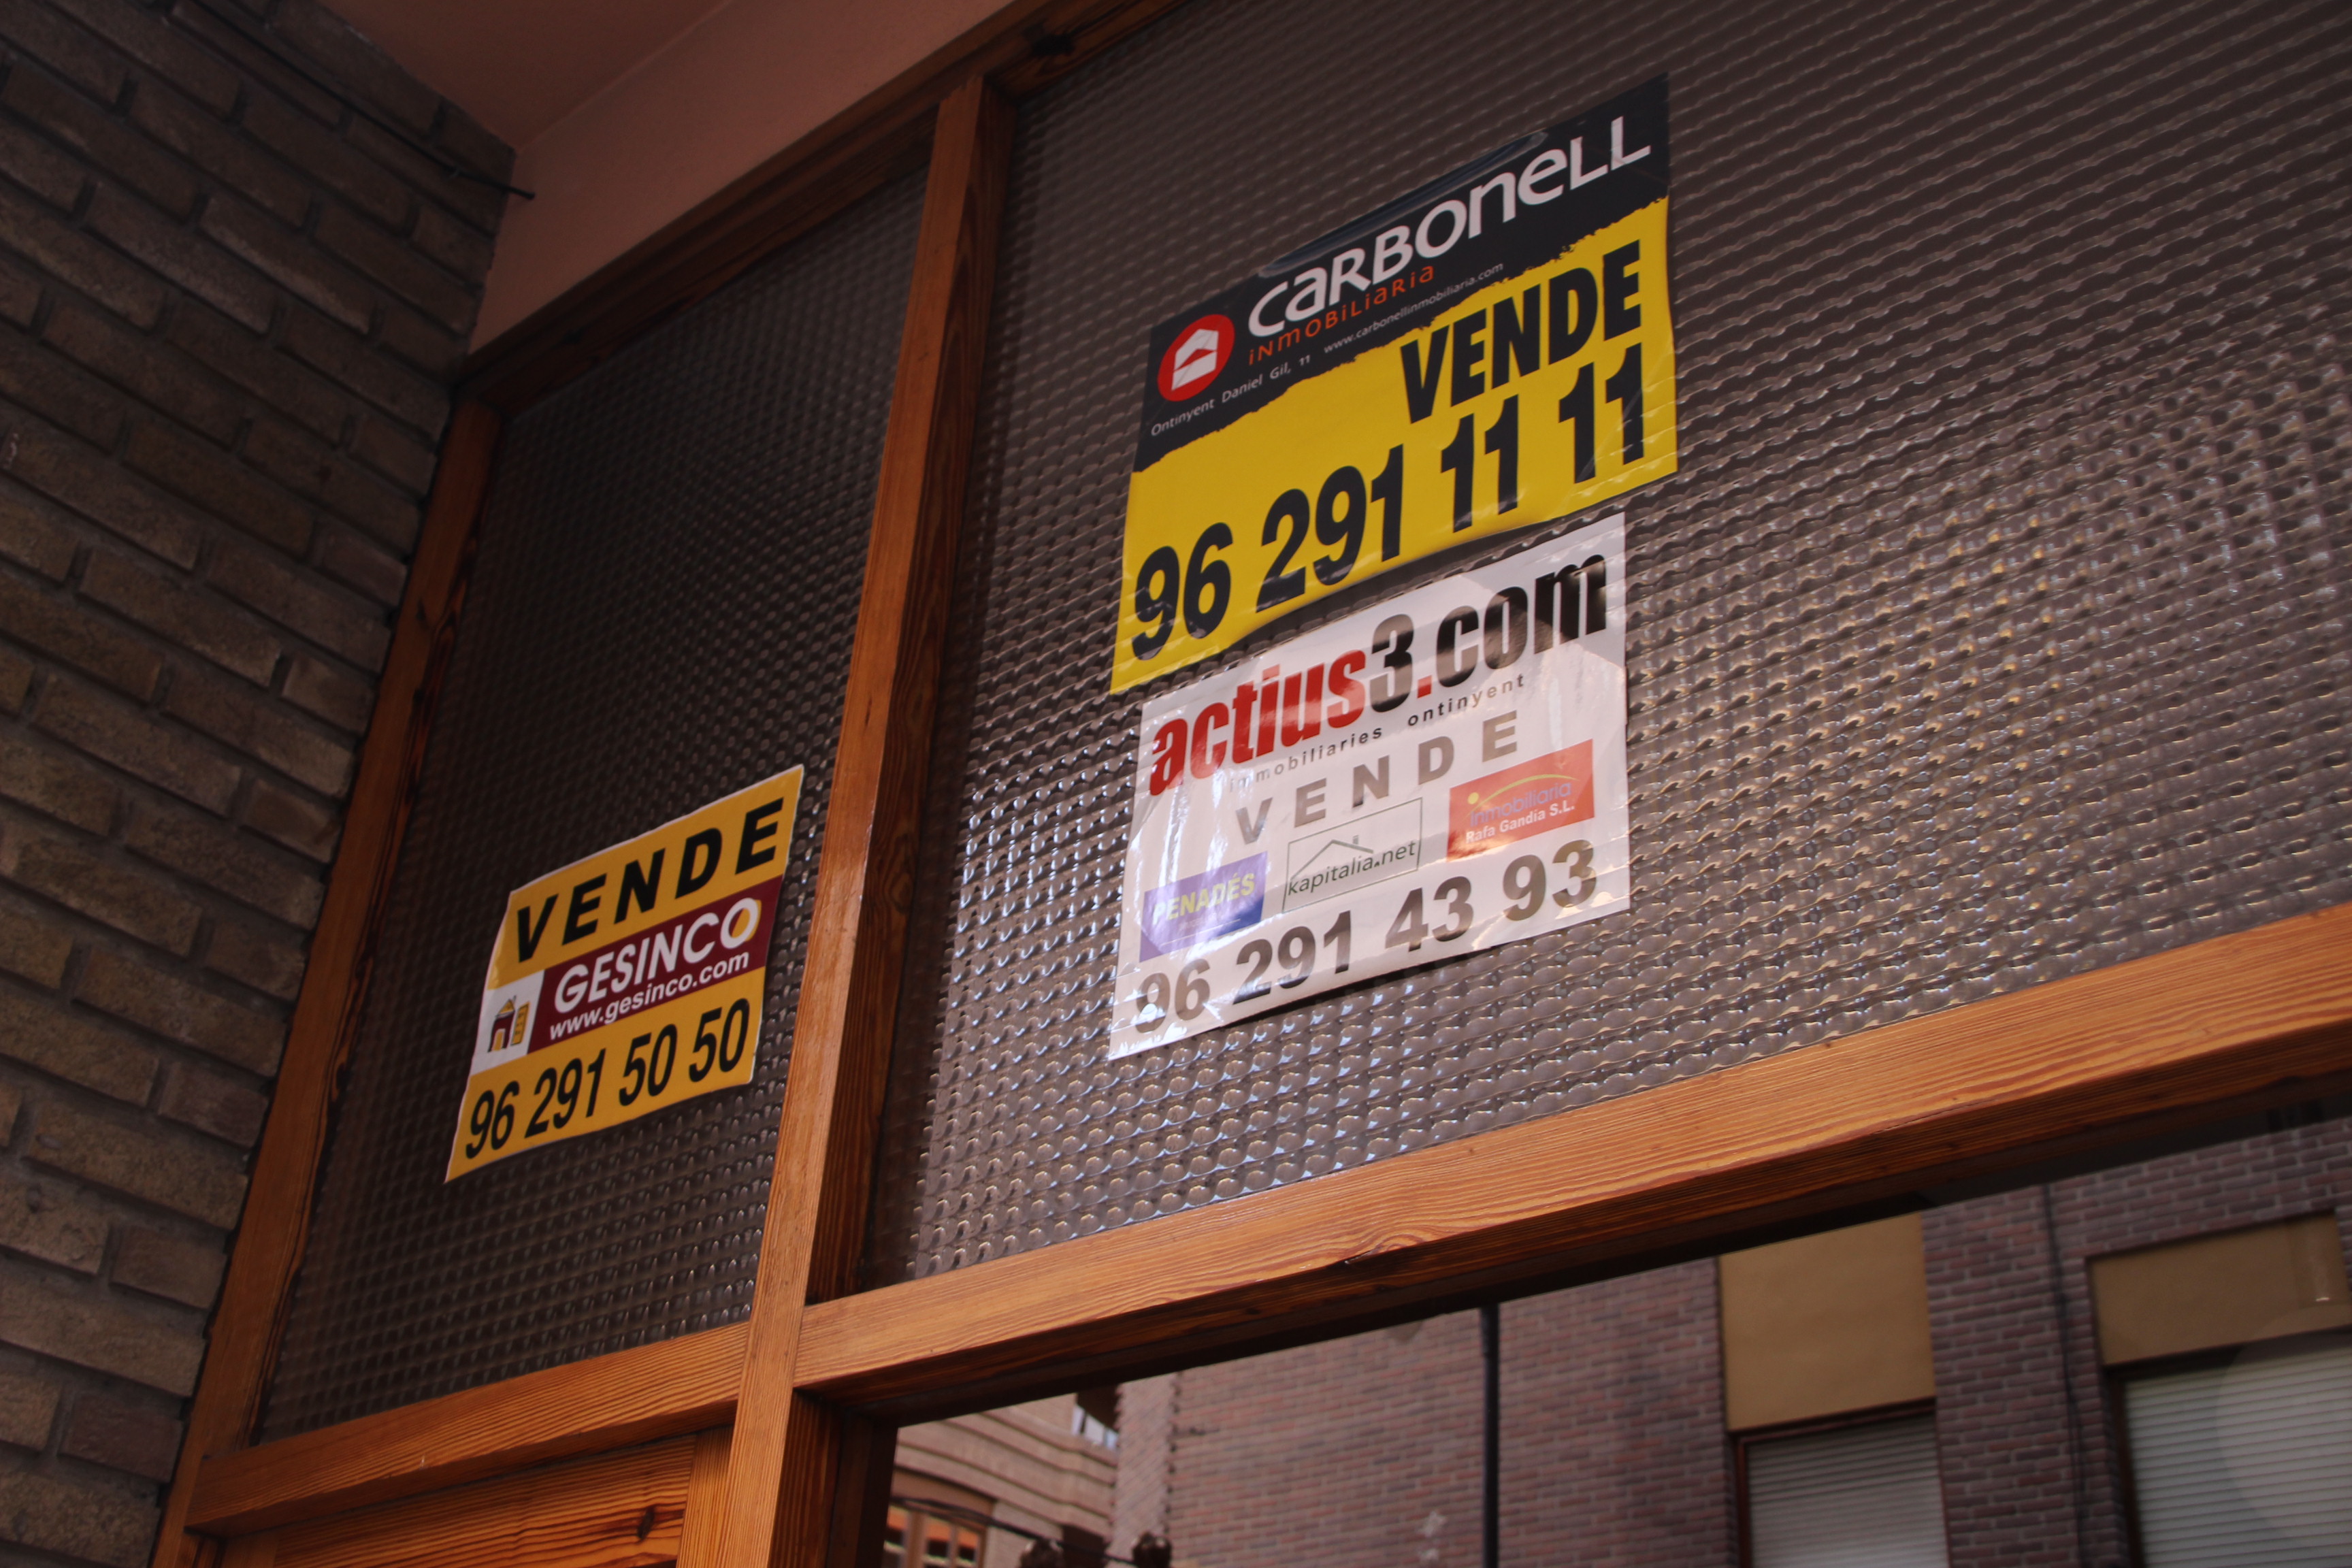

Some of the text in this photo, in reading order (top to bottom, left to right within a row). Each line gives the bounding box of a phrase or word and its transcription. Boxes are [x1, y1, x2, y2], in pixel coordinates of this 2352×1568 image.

[1151, 262, 1504, 437] Ontinyent Daniel Gil, 11 www.carbonellinmobiliaria.com
[1400, 239, 1642, 424] VENDE
[1132, 342, 1644, 660] 96 291 11 11
[1149, 553, 1607, 796] actius3.com
[1230, 672, 1524, 793] immobiliaries ontinyent
[1235, 710, 1518, 845] VENDE
[1465, 825, 1496, 844] Rafa
[1549, 799, 1575, 817] S.L.
[1469, 781, 1572, 827] Inmobiliaria
[517, 797, 784, 963] VENDE
[1152, 872, 1255, 926] PENADÉS
[1288, 840, 1416, 896] kapitalia.net
[549, 952, 749, 1041] www.gesinco.com
[554, 898, 762, 1014] GESINCO
[1136, 839, 1597, 1034] 96 291 43 93
[465, 998, 751, 1160] 96 291 50 50
